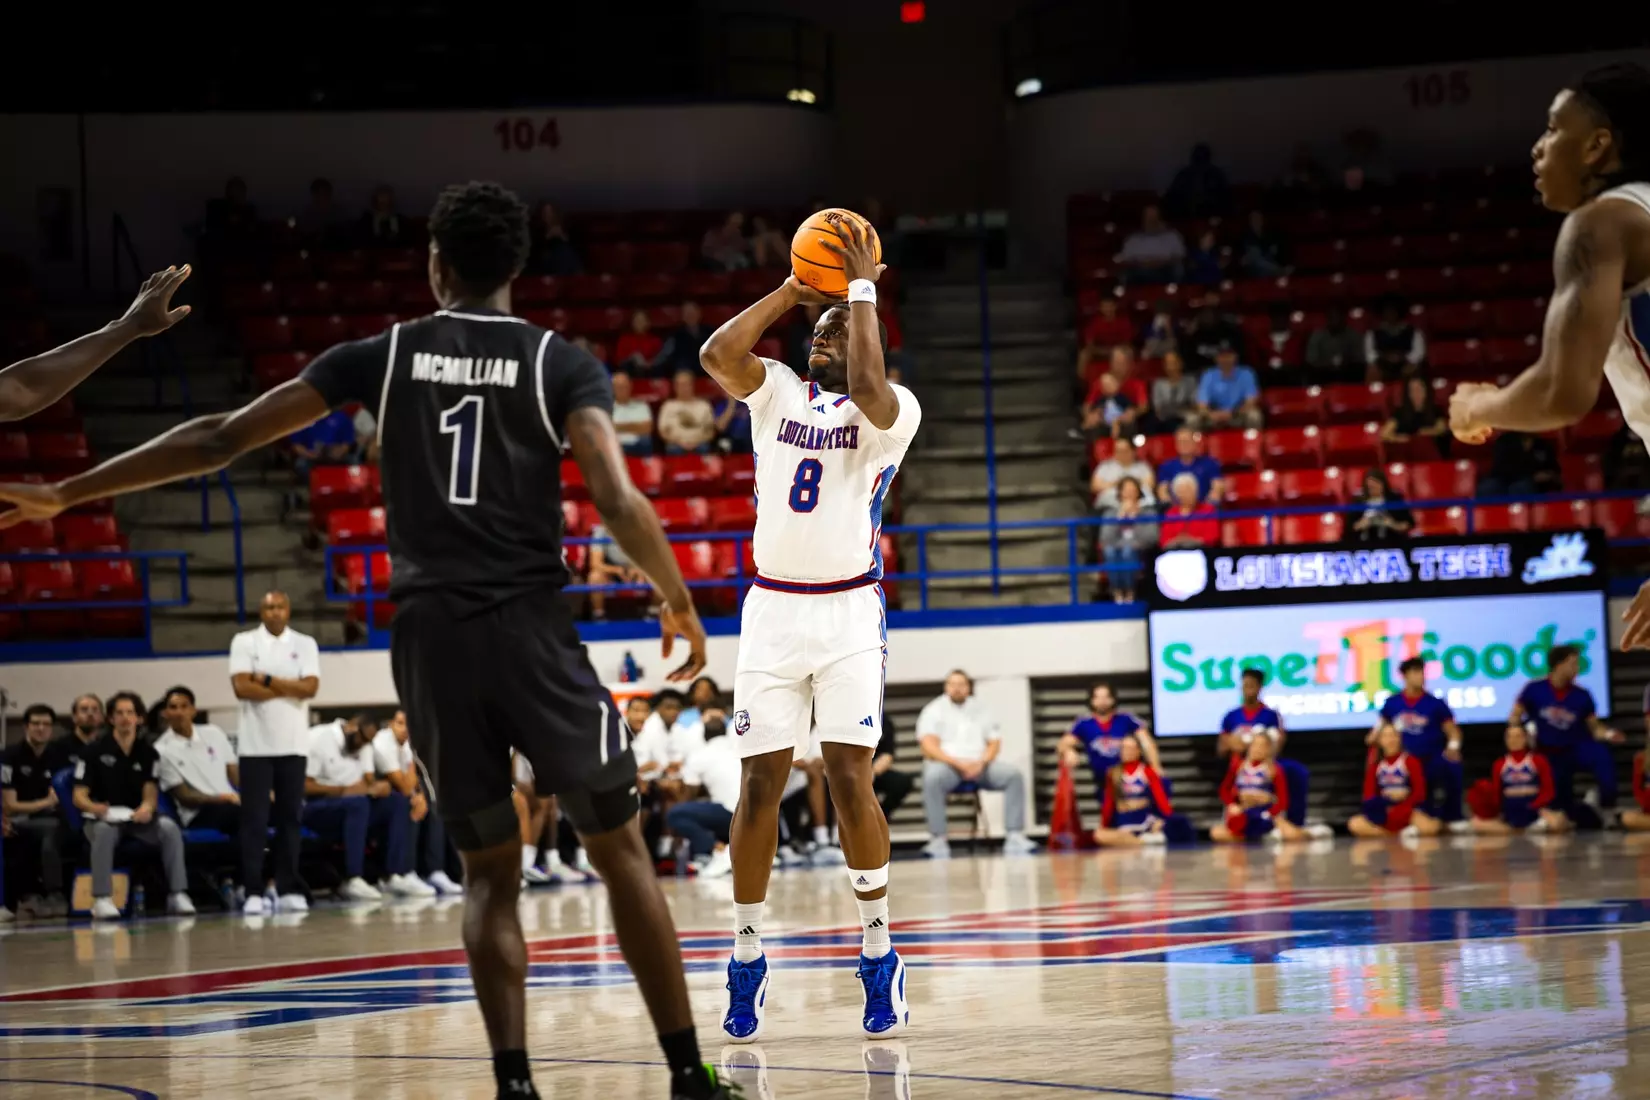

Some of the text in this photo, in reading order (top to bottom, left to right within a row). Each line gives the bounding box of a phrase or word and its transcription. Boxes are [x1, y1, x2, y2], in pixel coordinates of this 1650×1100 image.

[1402, 70, 1471, 109] 105
[494, 116, 562, 152] 104
[411, 352, 520, 388] MCMILLIAN
[439, 394, 485, 505] 1
[776, 417, 830, 450] LOUISAN
[788, 457, 824, 513] 8
[1214, 543, 1512, 591] LOUISIANA TECH
